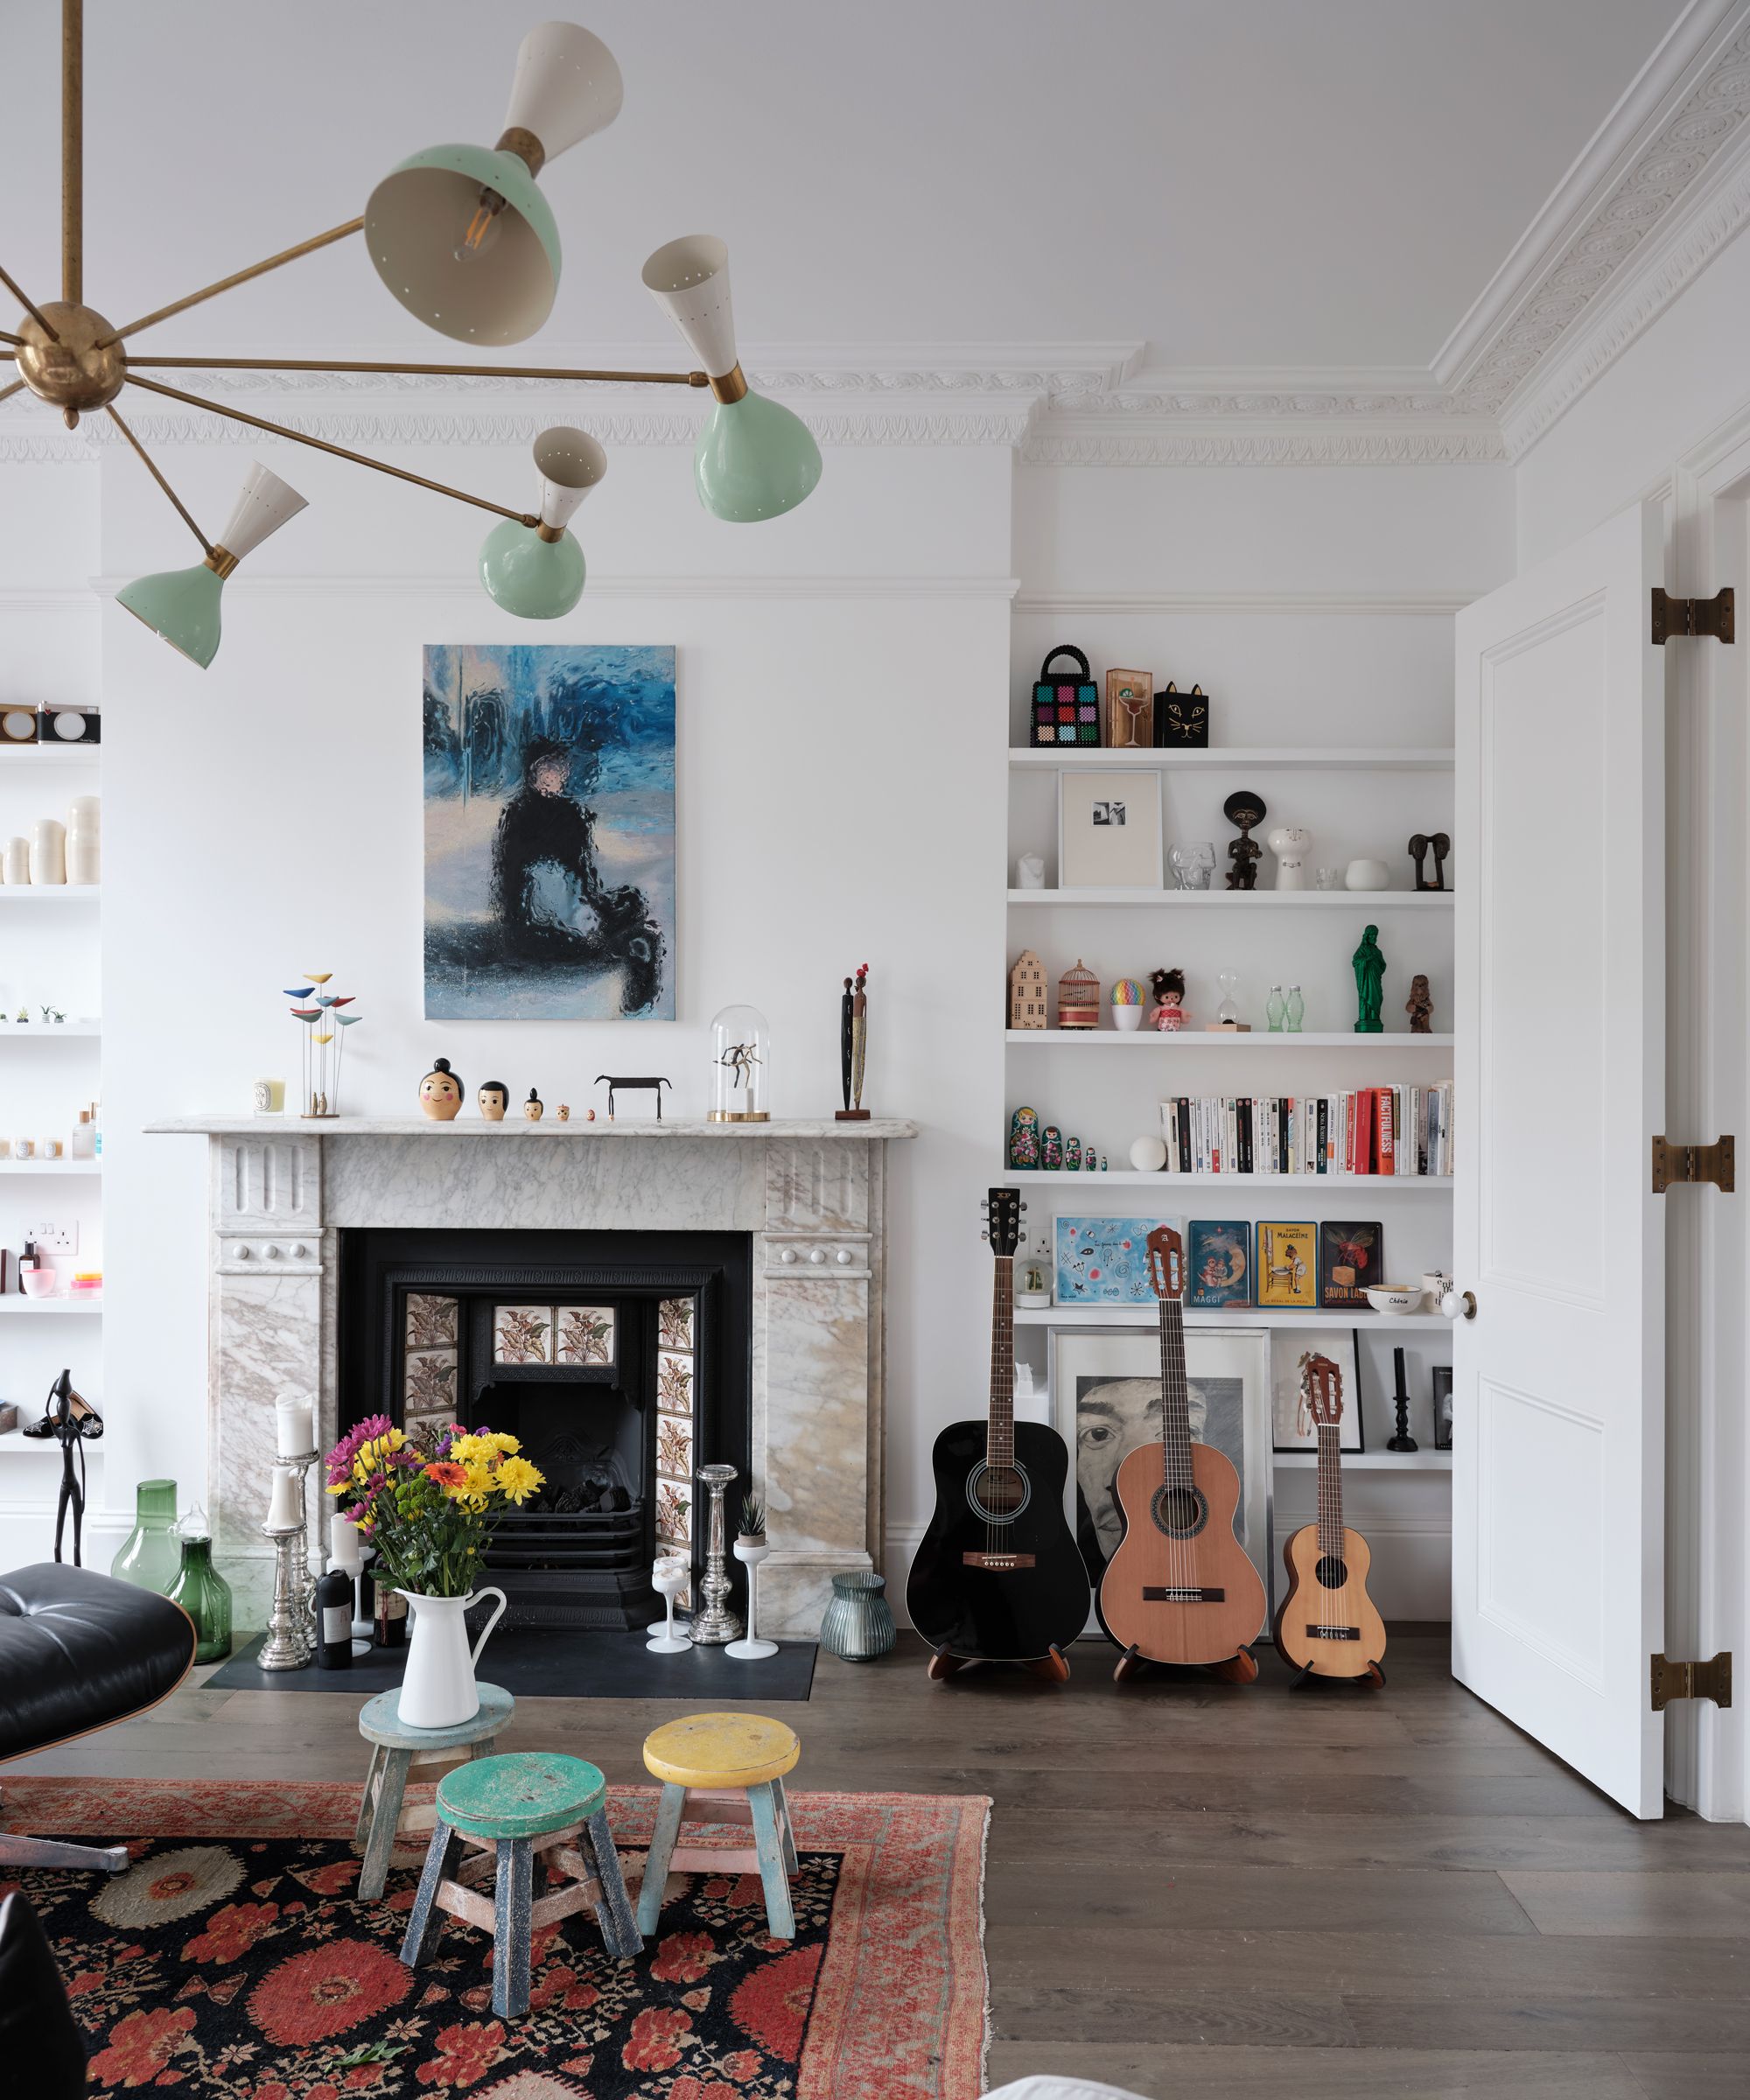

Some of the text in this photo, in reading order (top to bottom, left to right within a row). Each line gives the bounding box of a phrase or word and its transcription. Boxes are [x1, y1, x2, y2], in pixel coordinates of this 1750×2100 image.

[1381, 1096, 1392, 1153] FACTFULNESS
[1325, 1286, 1348, 1298] SAVON
[1194, 1295, 1220, 1304] MAGGI
